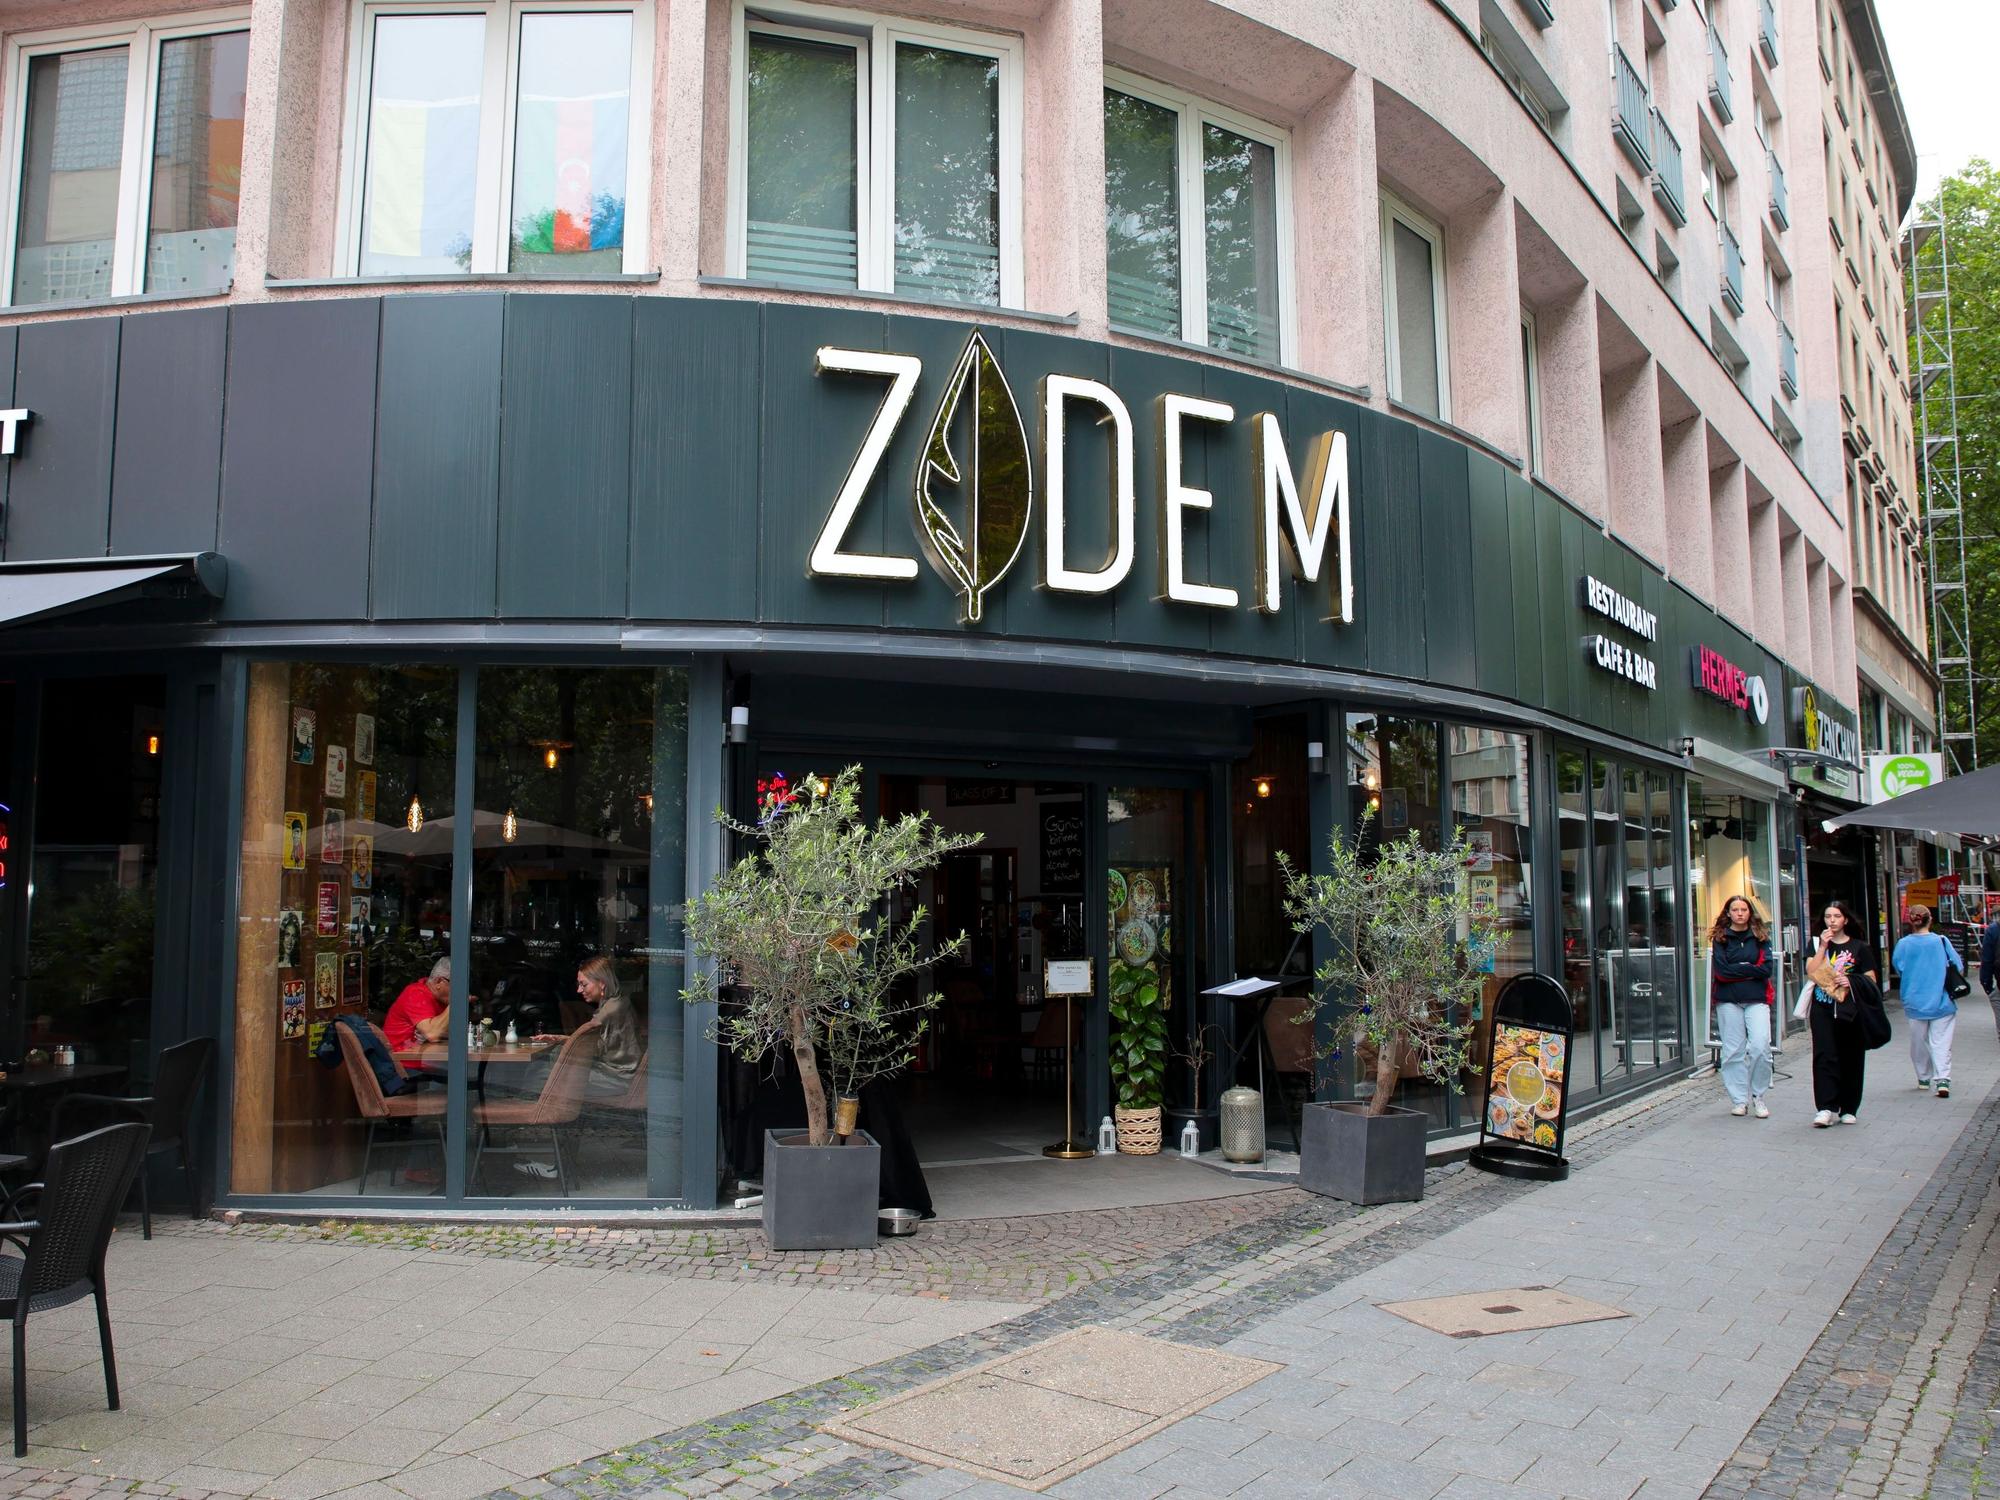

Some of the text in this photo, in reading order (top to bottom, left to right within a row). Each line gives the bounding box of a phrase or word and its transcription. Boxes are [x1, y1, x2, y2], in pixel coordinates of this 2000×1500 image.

[1587, 575, 1656, 642] RESTAURANT
[1595, 634, 1657, 690] CAFE & BAR
[1700, 642, 1749, 710] HERMES
[1897, 769, 1925, 777] VEGAN
